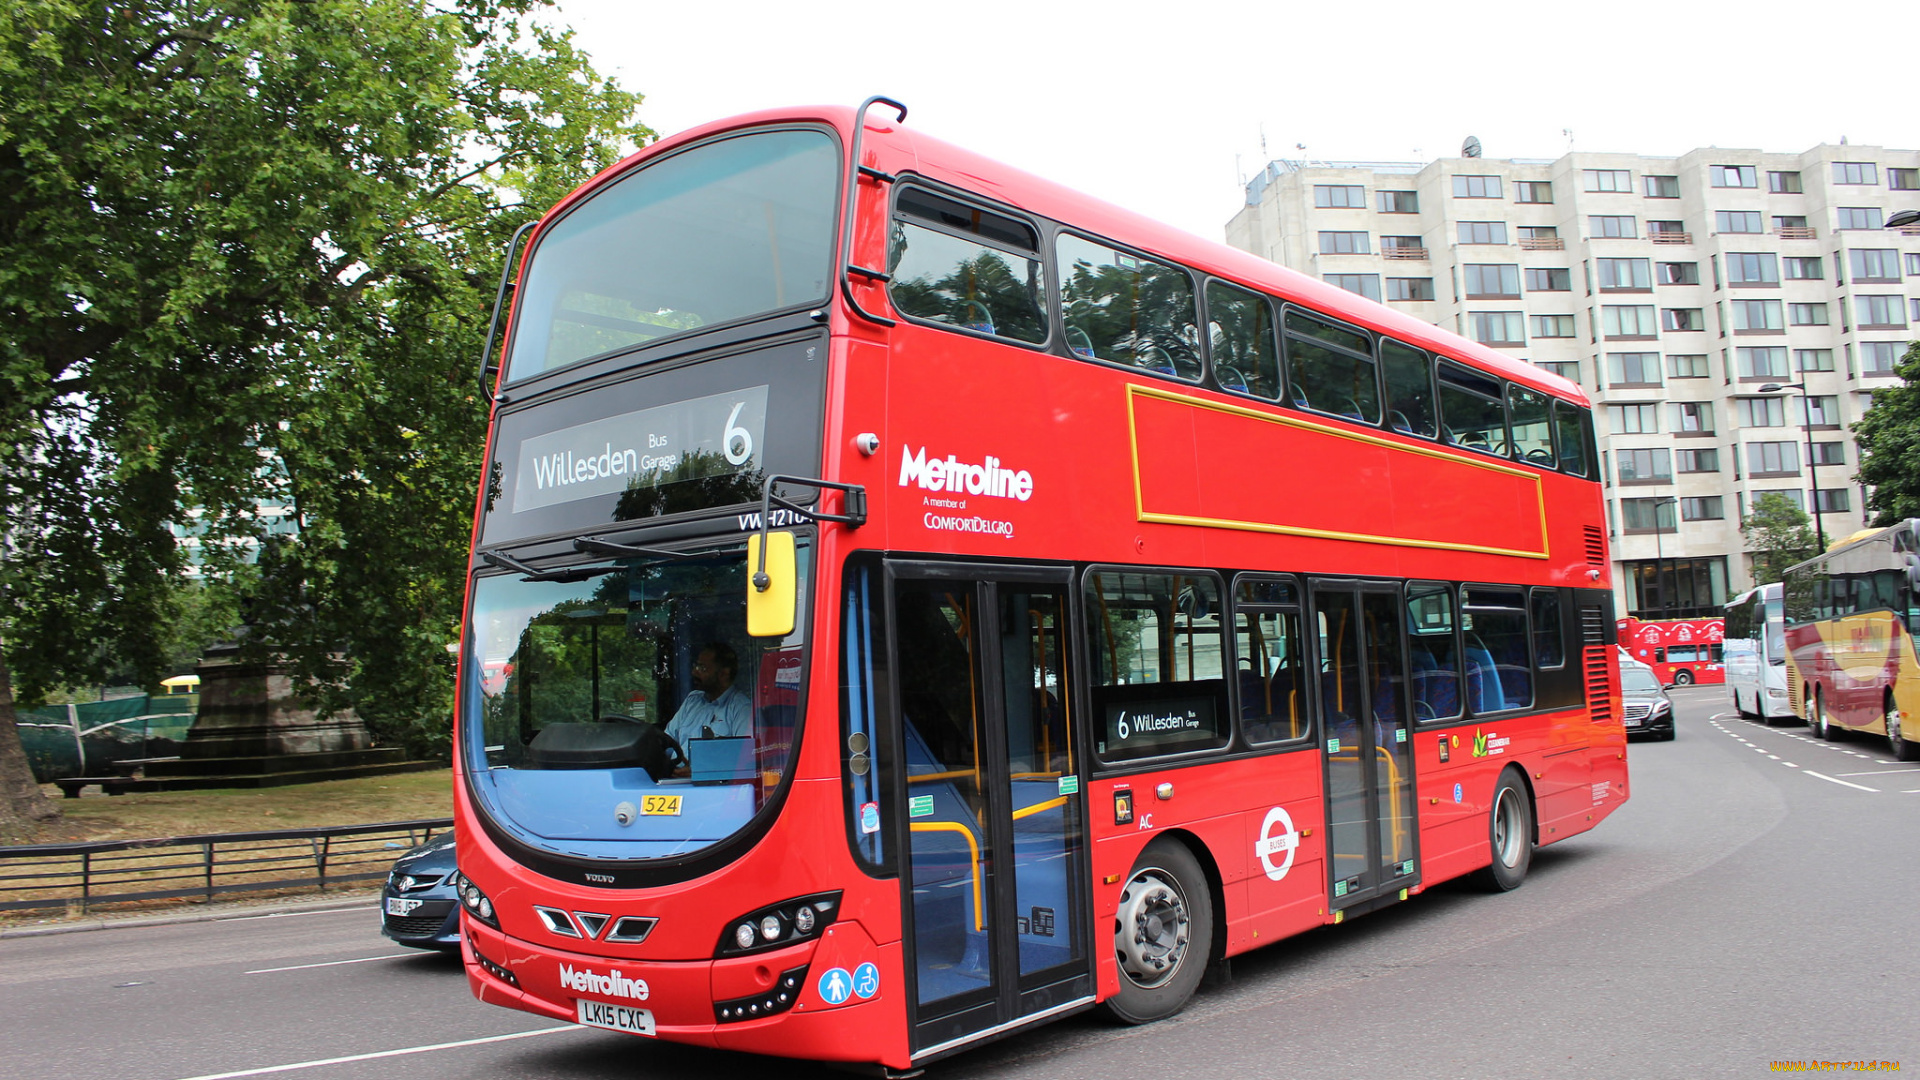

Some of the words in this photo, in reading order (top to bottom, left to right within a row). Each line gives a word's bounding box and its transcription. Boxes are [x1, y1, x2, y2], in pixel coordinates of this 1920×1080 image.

[649, 433, 668, 449] Bus
[723, 402, 752, 466] 6
[533, 443, 636, 490] Willesden
[641, 453, 677, 471] Garage
[899, 444, 1033, 501] Metroline
[923, 496, 930, 506] A
[930, 498, 958, 509] member
[959, 499, 966, 509] of
[1118, 711, 1130, 740] 6
[1133, 712, 1184, 732] Willesden
[645, 797, 679, 813] 524
[1139, 813, 1154, 830] AC
[1269, 838, 1286, 850] BUSES
[584, 873, 615, 884] VOLVO
[559, 962, 650, 1001] Metroline
[584, 1002, 615, 1026] LK15
[617, 1008, 646, 1031] CXC
